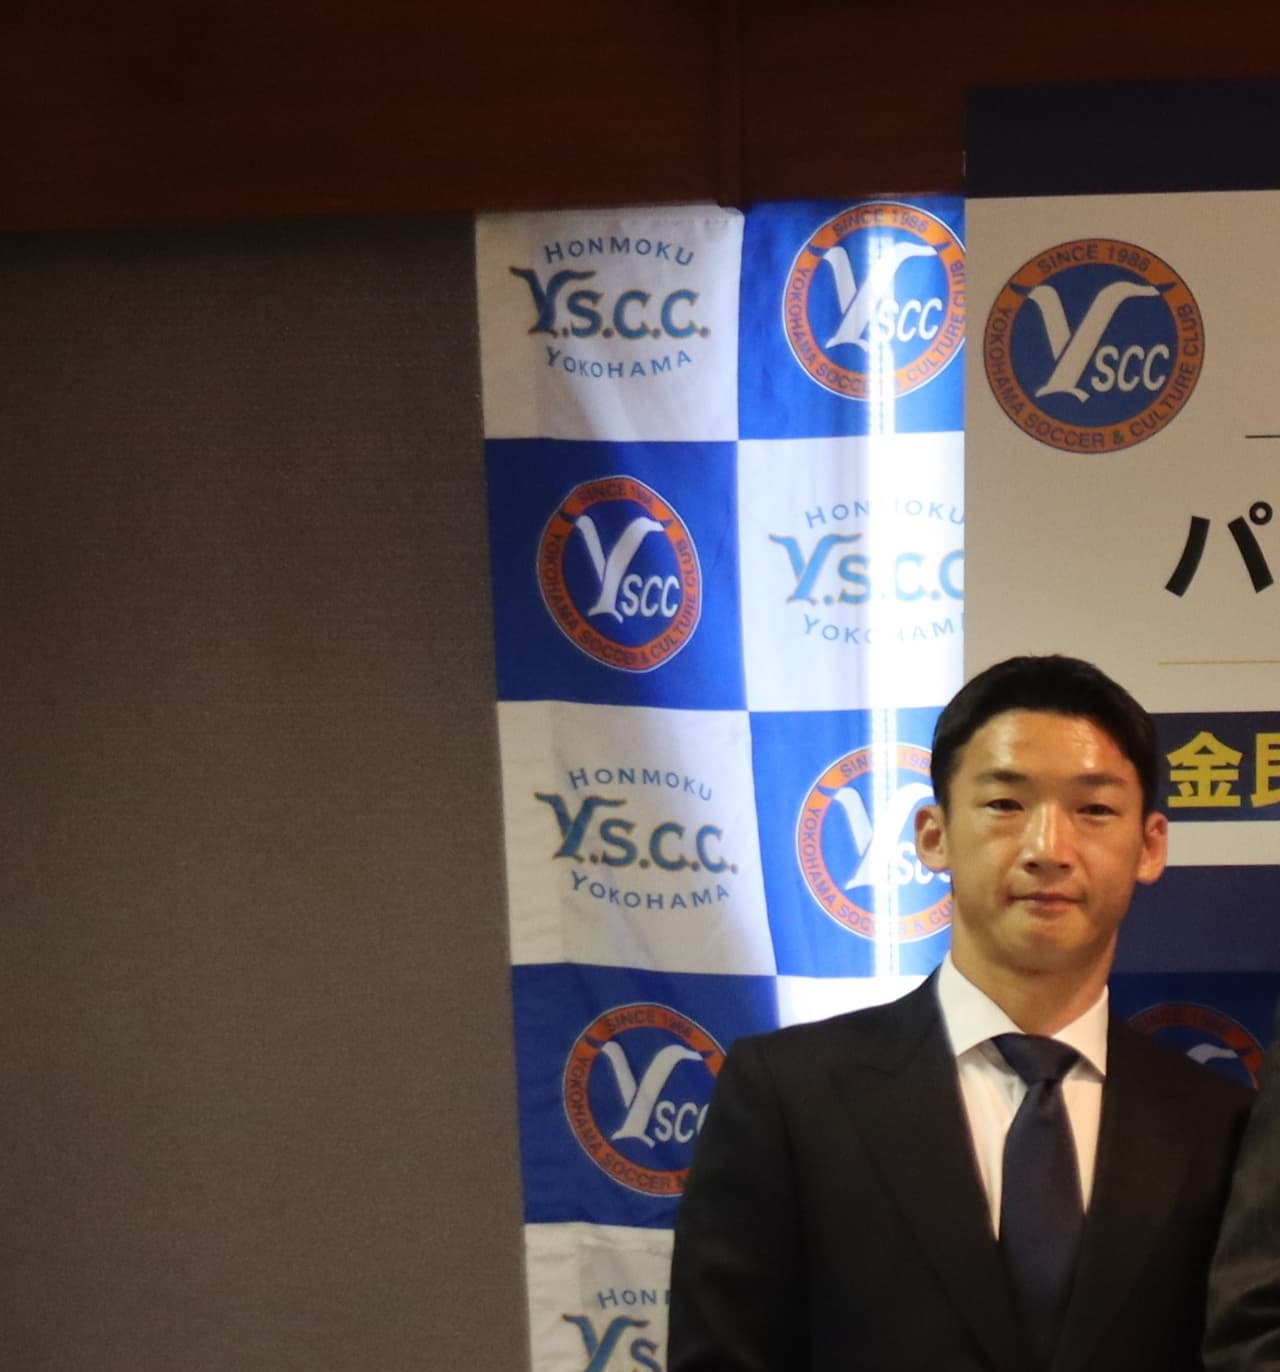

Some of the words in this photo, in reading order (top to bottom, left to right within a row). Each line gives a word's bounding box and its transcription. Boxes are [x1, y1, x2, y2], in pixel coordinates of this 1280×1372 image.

[832, 209, 884, 237] SINCE
[543, 236, 694, 266] HONMOKU
[1037, 245, 1098, 275] SINCE
[1108, 247, 1150, 272] 1986
[508, 265, 711, 340] Y.S.C.C.
[789, 268, 817, 364] YOKOHAMA
[546, 346, 692, 378] YOKOHAMA
[990, 308, 1024, 415] YOKOHAMA
[1025, 413, 1105, 447] SOCCER
[1112, 431, 1126, 445] &
[1129, 363, 1194, 436] CULTURE
[1178, 304, 1199, 356] CLUB
[805, 499, 964, 529] HONOKU
[568, 767, 714, 802] HONMOKU
[533, 792, 739, 875] Y.S.C.C.
[802, 808, 837, 907] YOKOHAMA
[570, 870, 731, 910] YOKOHAMA
